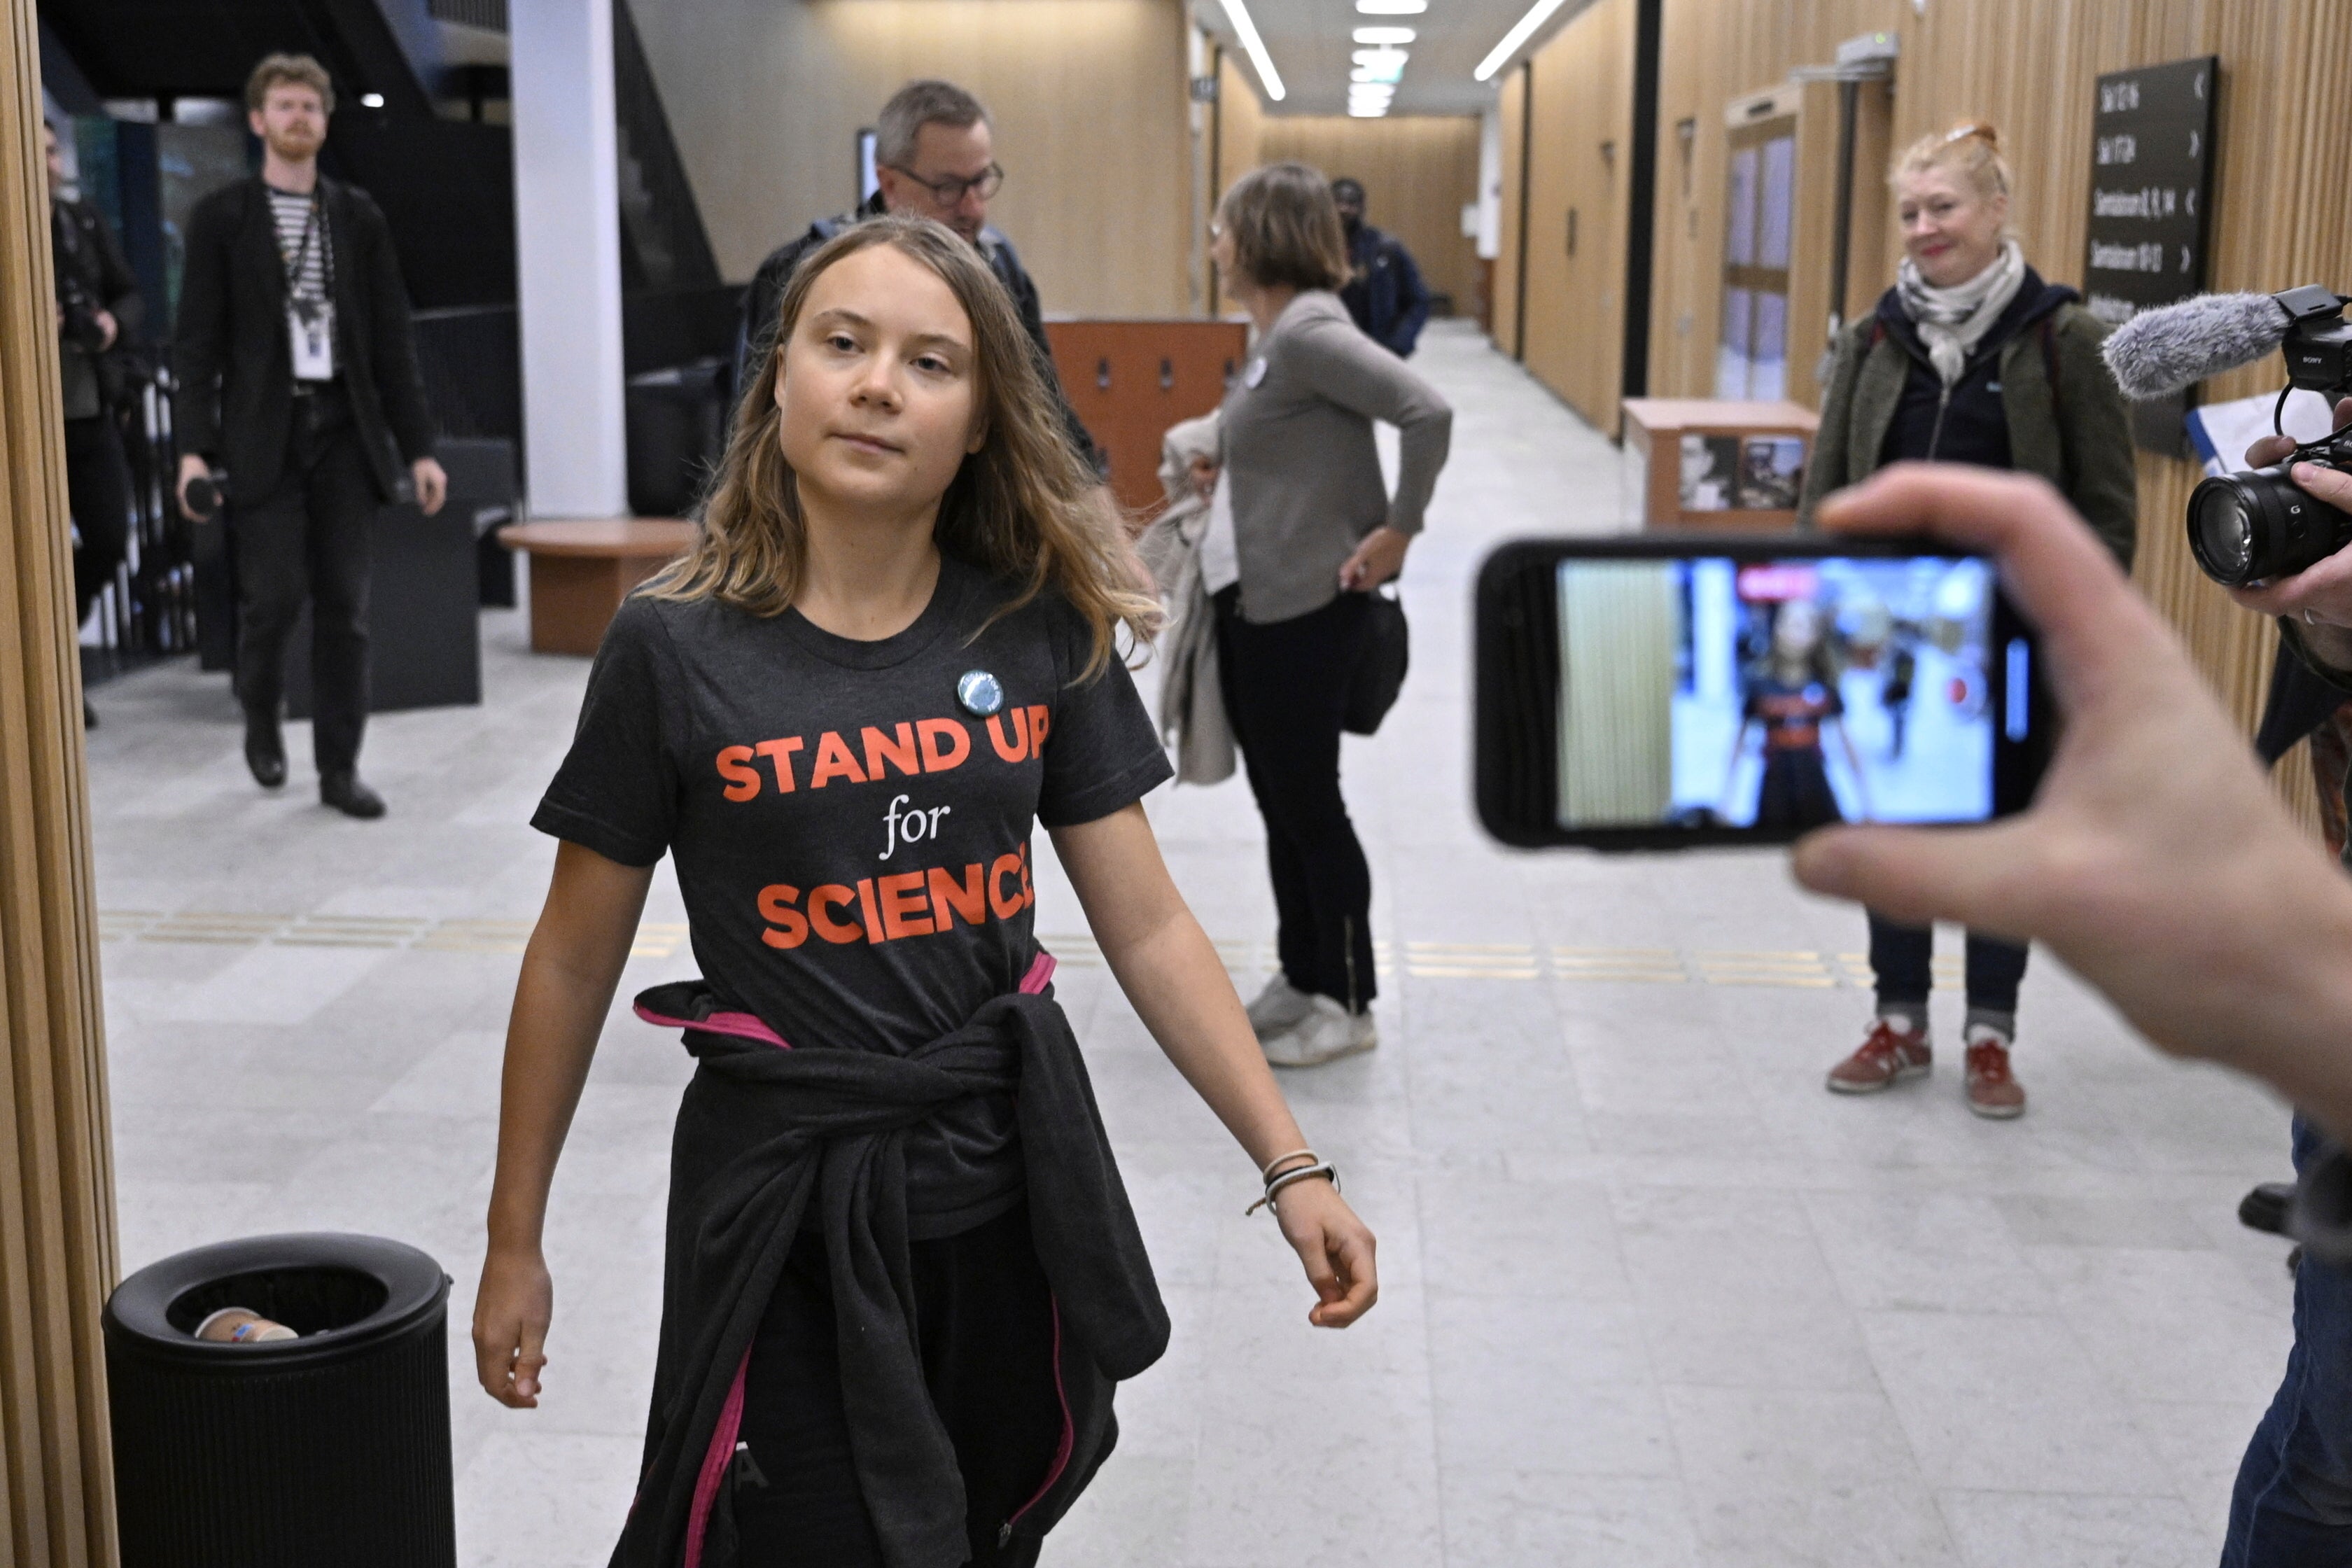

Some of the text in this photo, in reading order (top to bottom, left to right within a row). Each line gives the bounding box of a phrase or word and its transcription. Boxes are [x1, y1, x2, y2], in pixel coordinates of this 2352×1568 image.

[2290, 505, 2301, 514] G
[715, 704, 1049, 803] STAND UP
[878, 794, 951, 861] for
